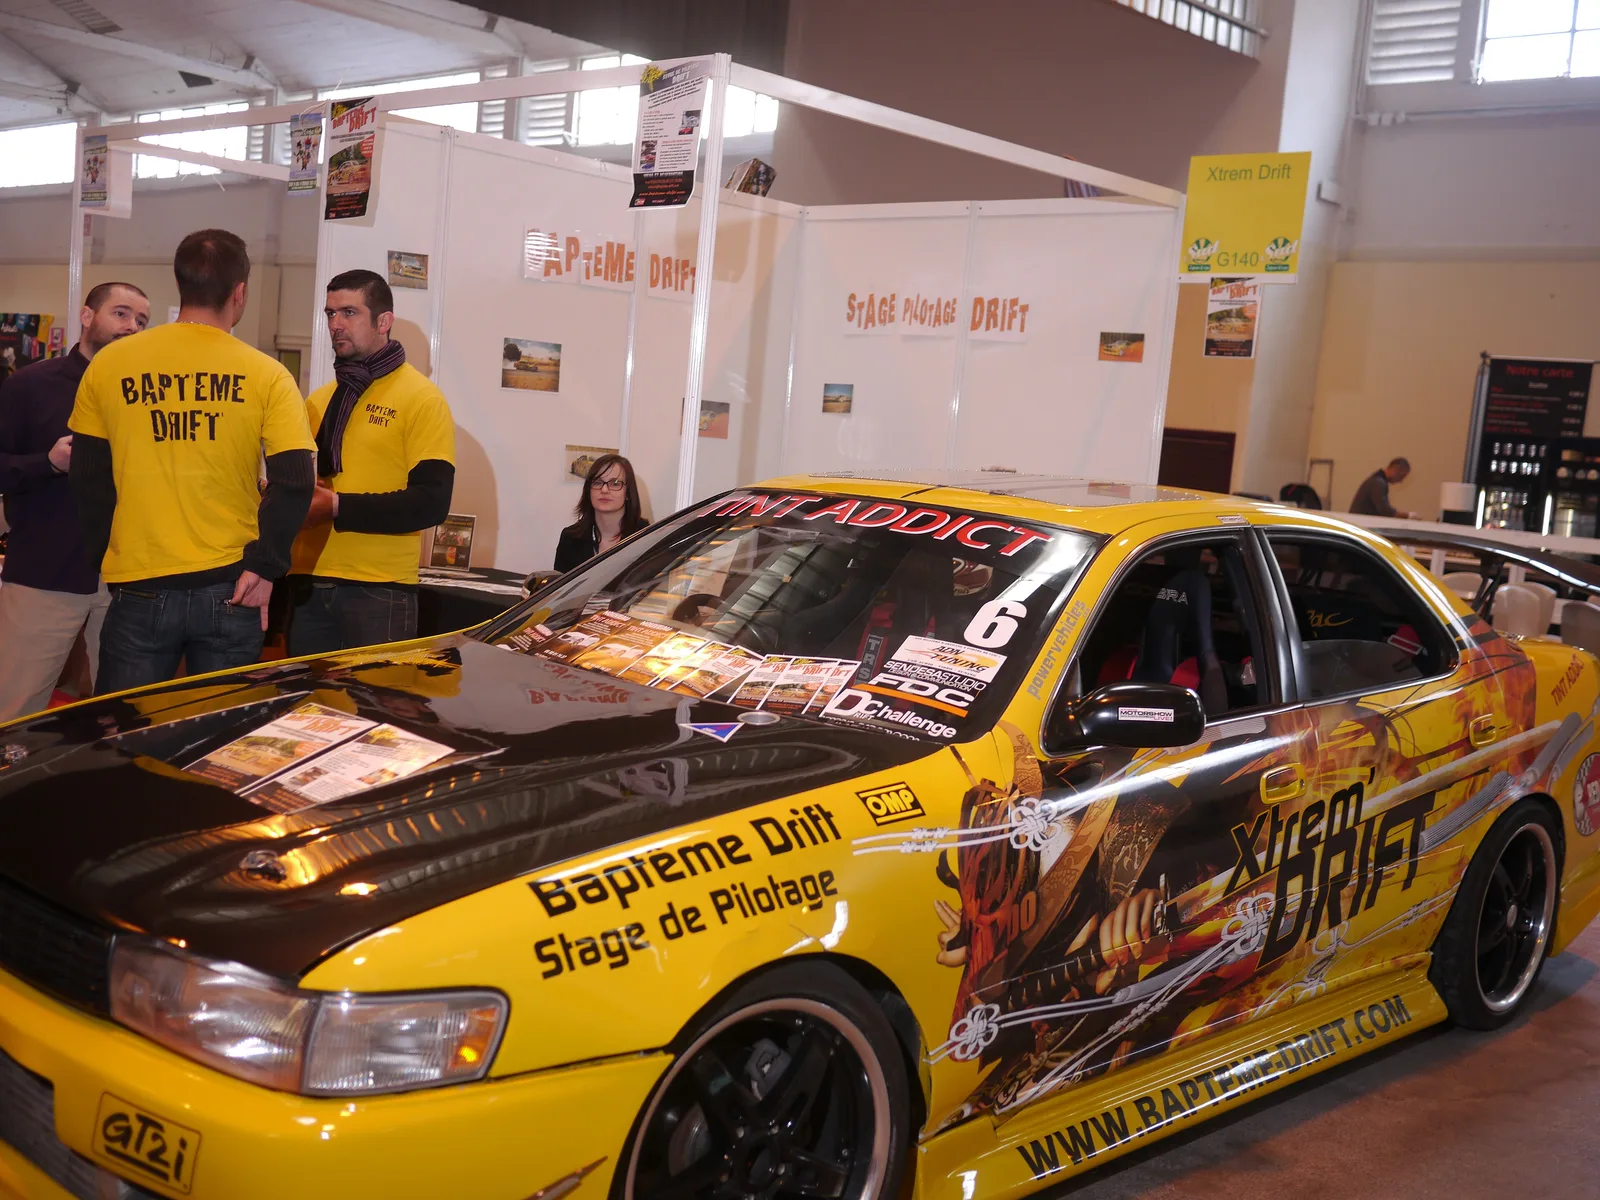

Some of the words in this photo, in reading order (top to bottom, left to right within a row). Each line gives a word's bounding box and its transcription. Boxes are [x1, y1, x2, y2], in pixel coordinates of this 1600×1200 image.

[1207, 166, 1253, 182] Xtrem
[1258, 163, 1292, 180] Drift
[1217, 251, 1259, 267] G140
[846, 293, 896, 330] STAGE
[903, 293, 957, 329] PILOTAGE
[970, 297, 1029, 333] DRIFT
[697, 494, 824, 518] TINT
[802, 499, 1055, 558] ADDICT
[963, 599, 1028, 649] 6
[931, 653, 990, 672] TUNING
[932, 645, 966, 656] ADN
[1027, 600, 1087, 701] powervehicles
[868, 672, 976, 708] FDC
[866, 789, 916, 813] OMP
[749, 803, 842, 856] Drift
[1254, 789, 1437, 972] DRIFT
[534, 921, 650, 979] Stage
[659, 902, 707, 940] de
[709, 869, 838, 925] Pilotage
[1016, 994, 1412, 1181] WWW.BAPTEME-DRIFT.COM
[102, 1112, 188, 1182] GT2i
